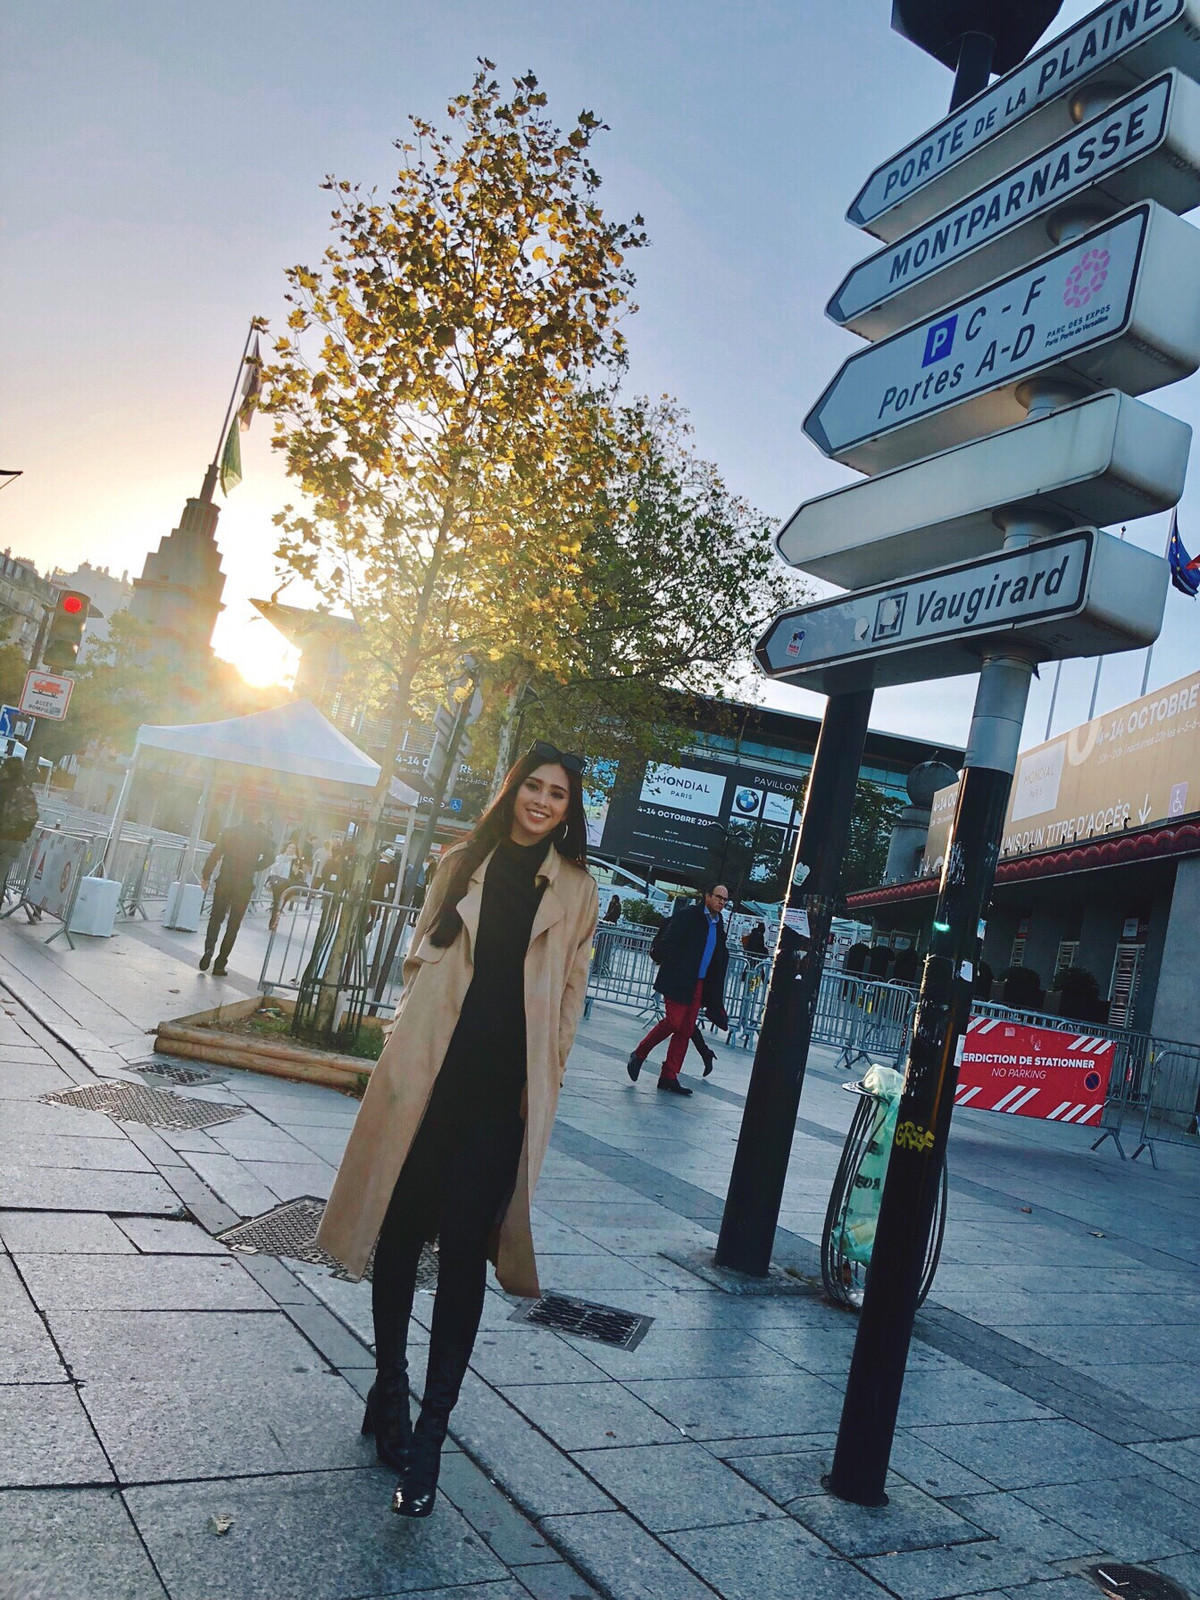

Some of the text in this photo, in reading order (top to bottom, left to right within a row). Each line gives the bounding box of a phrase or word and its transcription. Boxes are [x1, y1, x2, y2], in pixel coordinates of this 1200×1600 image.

[883, 0, 1162, 200] PORTE DE LA PLAINE
[889, 104, 1149, 283] MONTPARNASSE
[931, 327, 948, 358] P
[965, 306, 987, 342] C
[1022, 275, 1047, 316] F
[1046, 304, 1111, 339] PARC DES EXPOS
[1045, 337, 1059, 348] Paris
[1060, 331, 1075, 341] Porte
[878, 323, 1036, 420] Portes A-D
[916, 556, 1070, 625] Vaugirard
[1096, 683, 1200, 746] 4-14 OCTOBRE
[395, 753, 420, 766] 4-14
[657, 775, 711, 794] MONDIAL
[670, 790, 693, 800] PARIS
[754, 776, 799, 793] PAVILLON
[637, 805, 713, 827] 4-14 OCTOBRE 201
[1046, 817, 1076, 845] TITRE
[962, 1052, 1096, 1069] ERDICTION DE STATIONNER
[991, 1067, 1047, 1080] NO PARKING
